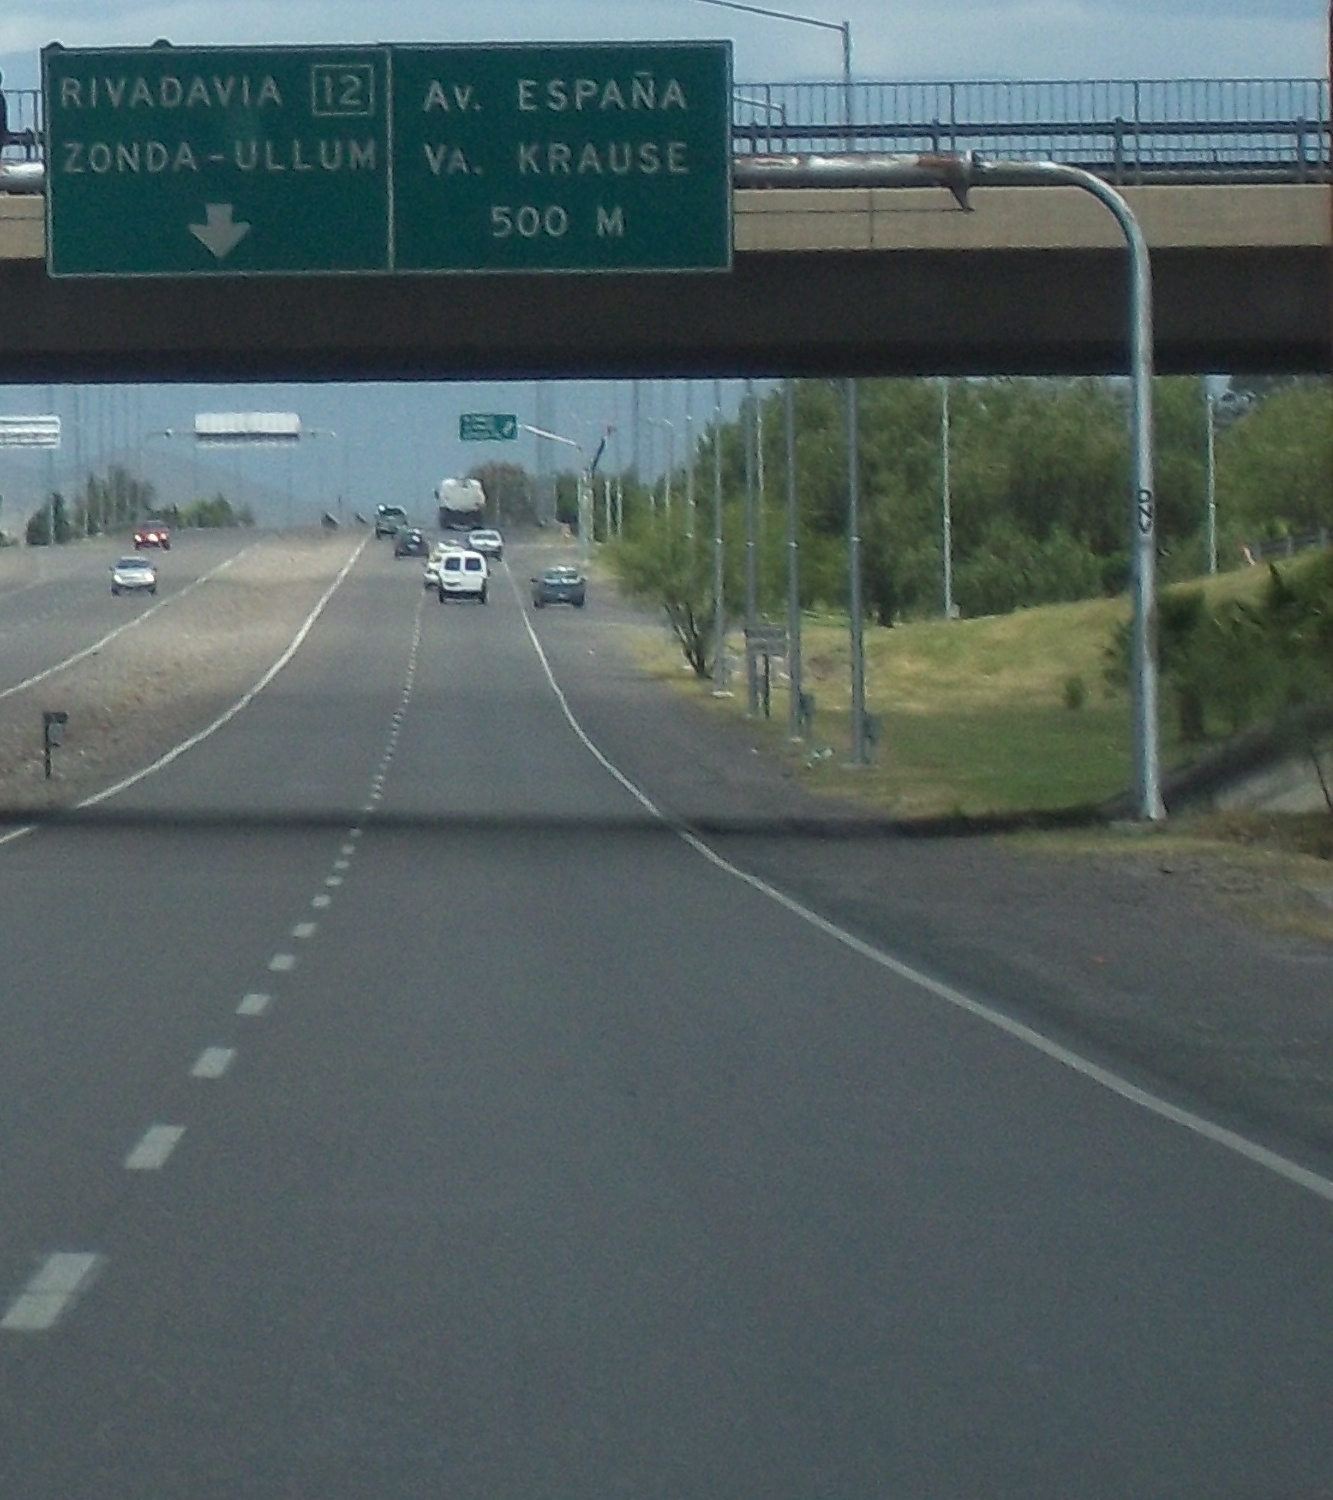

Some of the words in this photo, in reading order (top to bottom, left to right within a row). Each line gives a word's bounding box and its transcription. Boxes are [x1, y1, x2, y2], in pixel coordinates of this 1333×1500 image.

[61, 76, 282, 107] RIVADAVIA
[324, 74, 363, 106] 12
[517, 70, 687, 112] ESPAÑA
[518, 142, 689, 175] KRAUSE
[490, 205, 569, 238] 500
[596, 205, 625, 238] M
